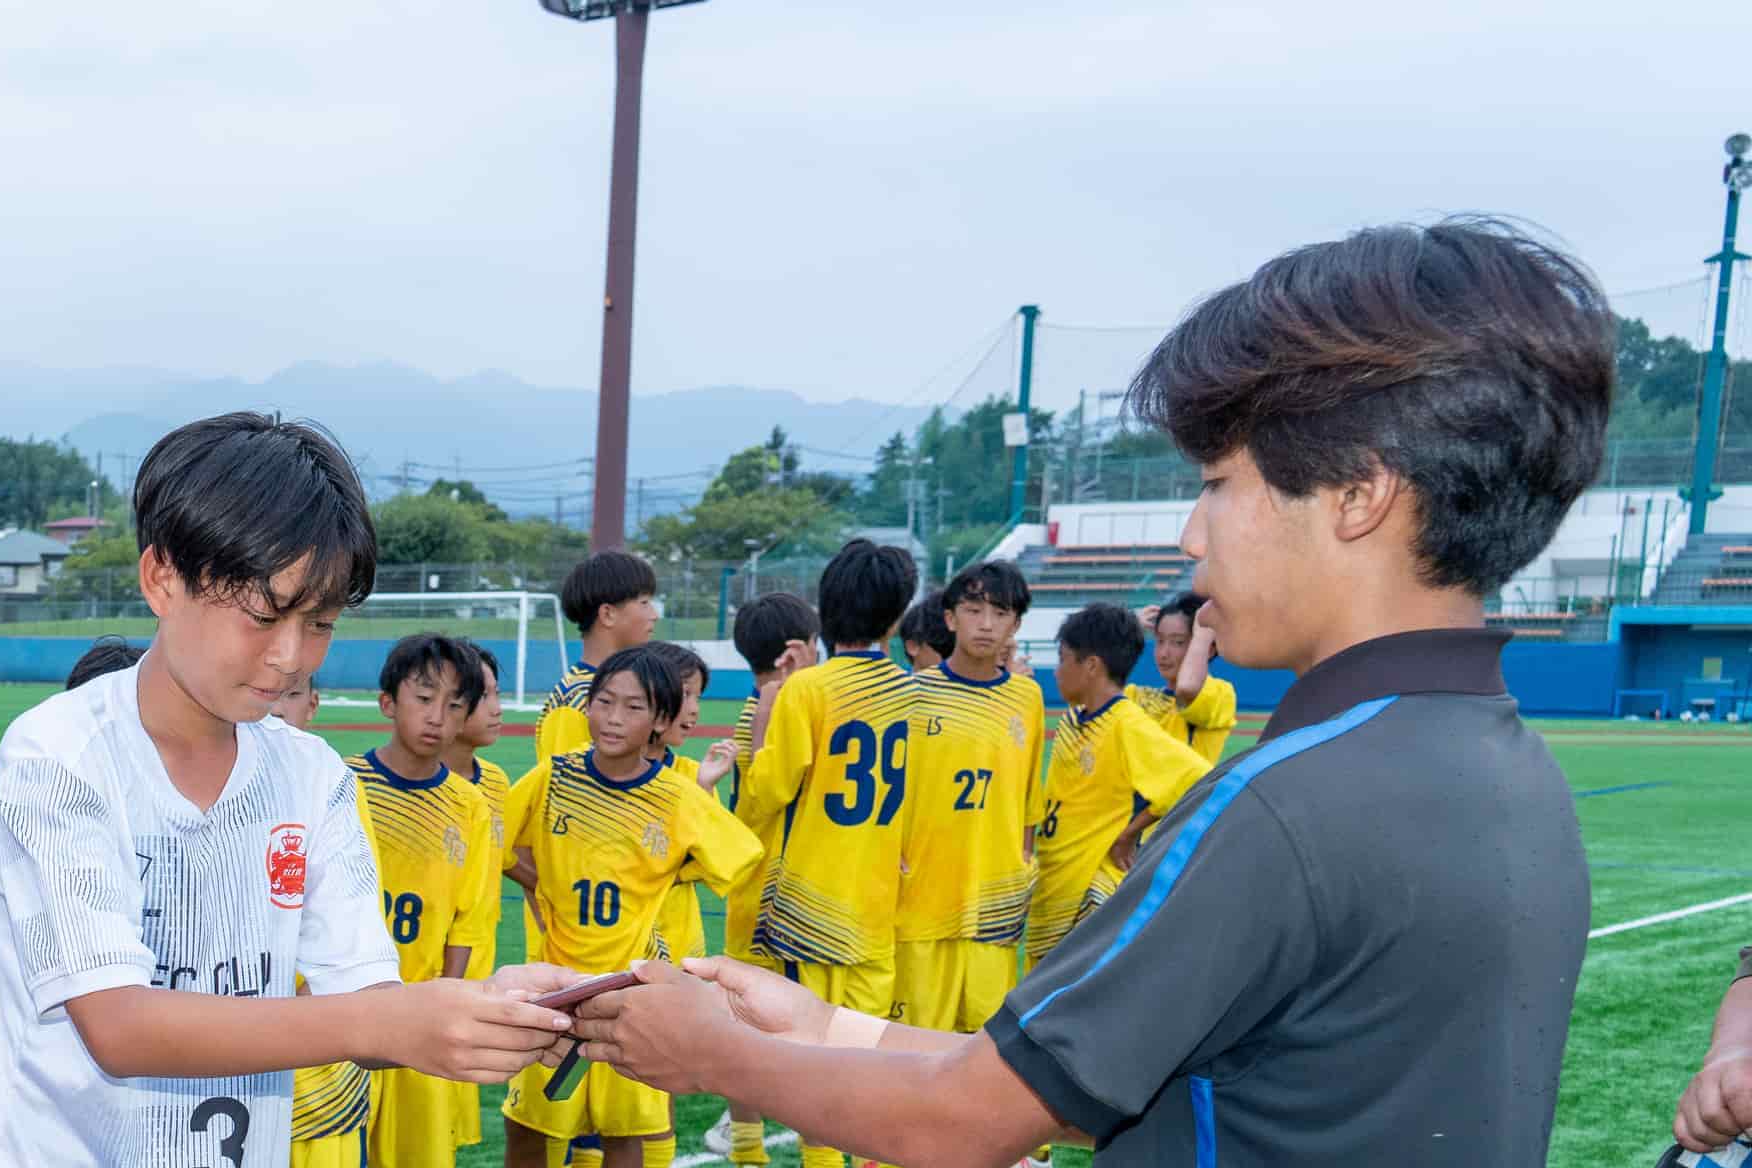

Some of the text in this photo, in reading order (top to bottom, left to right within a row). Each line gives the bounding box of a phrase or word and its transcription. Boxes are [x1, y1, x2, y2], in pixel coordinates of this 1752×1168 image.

[823, 719, 909, 827] 39
[953, 768, 993, 811] 27
[572, 878, 621, 928] 10
